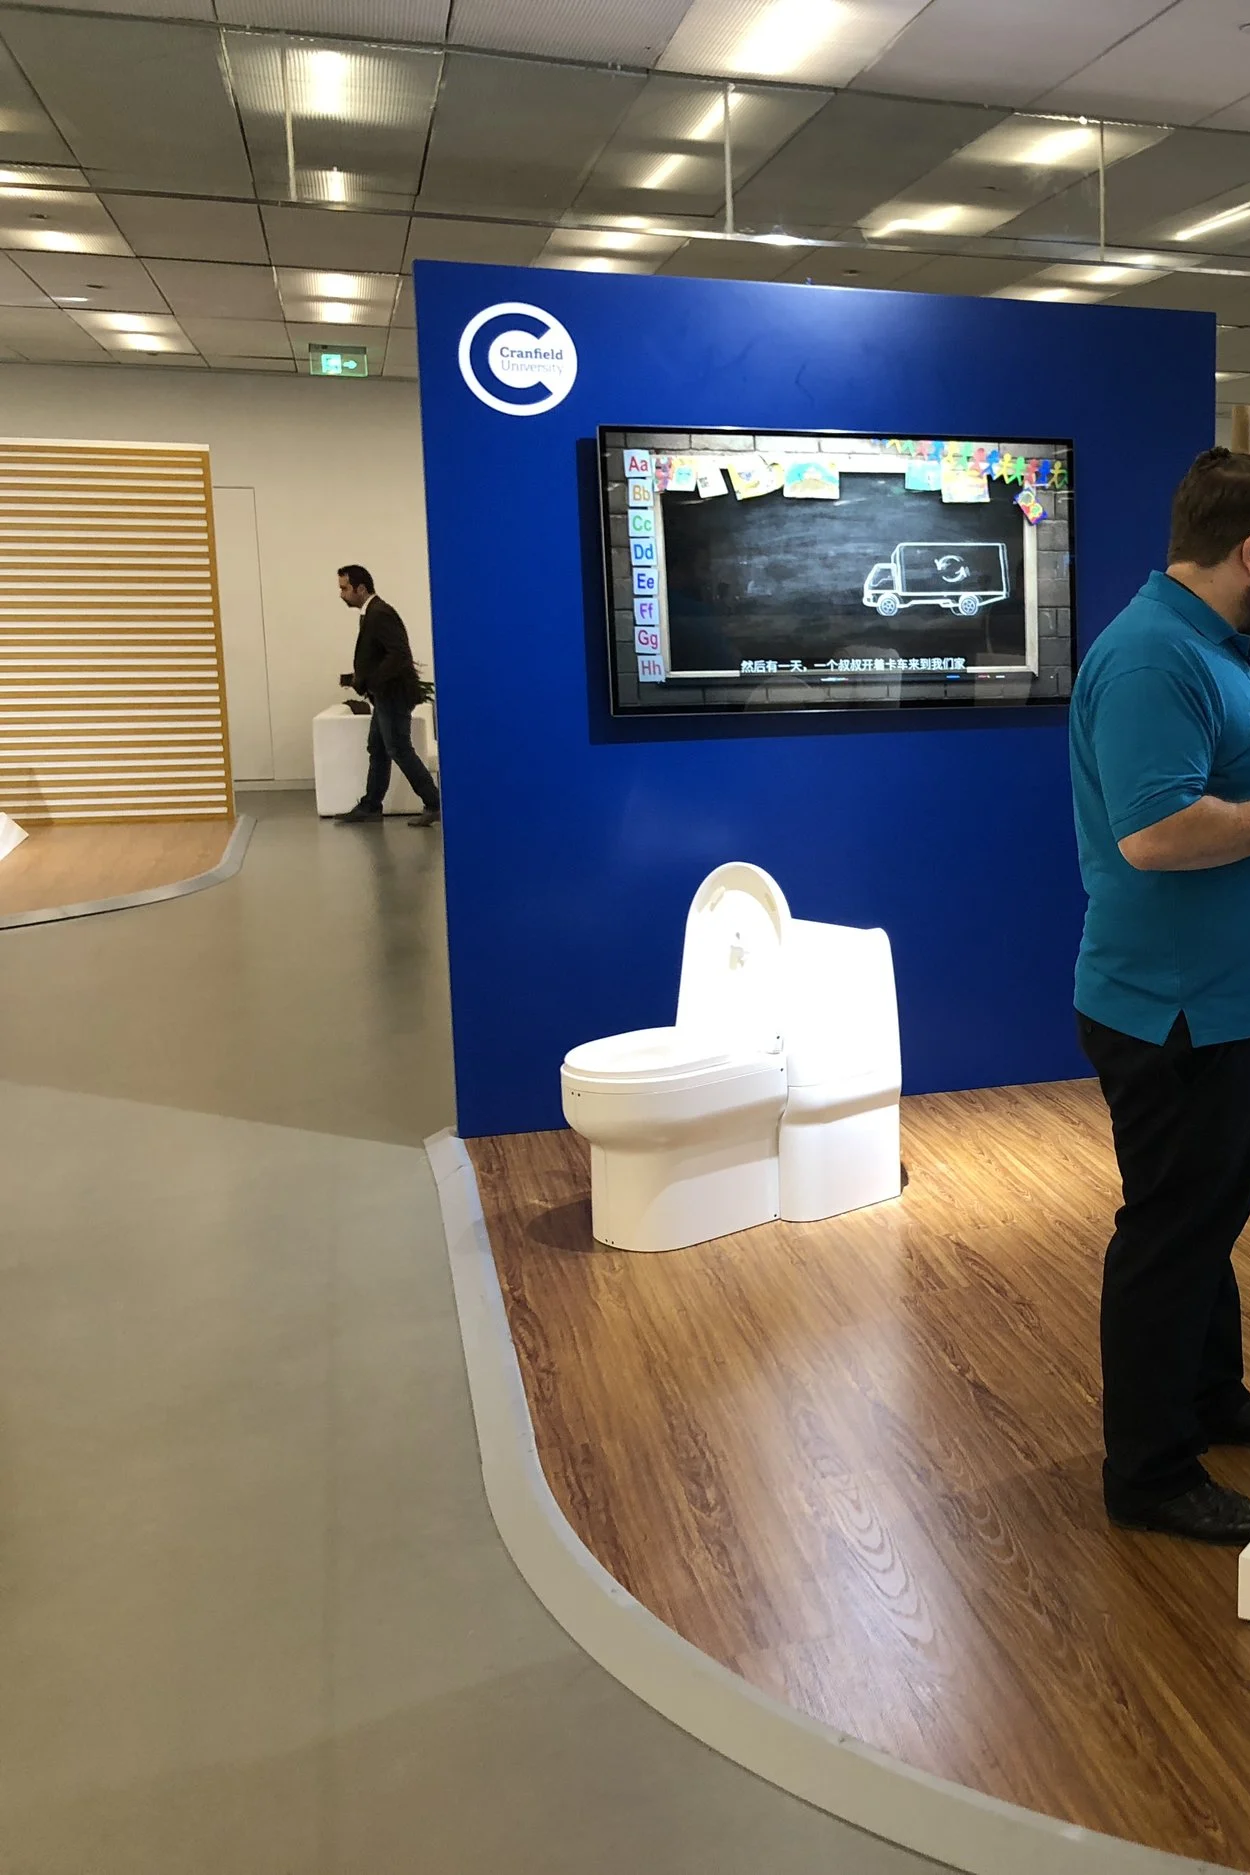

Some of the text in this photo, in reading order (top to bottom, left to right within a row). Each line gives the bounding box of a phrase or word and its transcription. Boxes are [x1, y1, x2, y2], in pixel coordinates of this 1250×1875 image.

[499, 346, 564, 361] Cranfield
[501, 360, 563, 376] University
[629, 456, 648, 472] Aa
[632, 484, 650, 502] Bb
[632, 515, 652, 532] Cc
[633, 543, 654, 560] Dd
[637, 573, 655, 590] Ee
[639, 602, 654, 620] Ff
[638, 629, 659, 650] Gg
[641, 660, 662, 676] Hh
